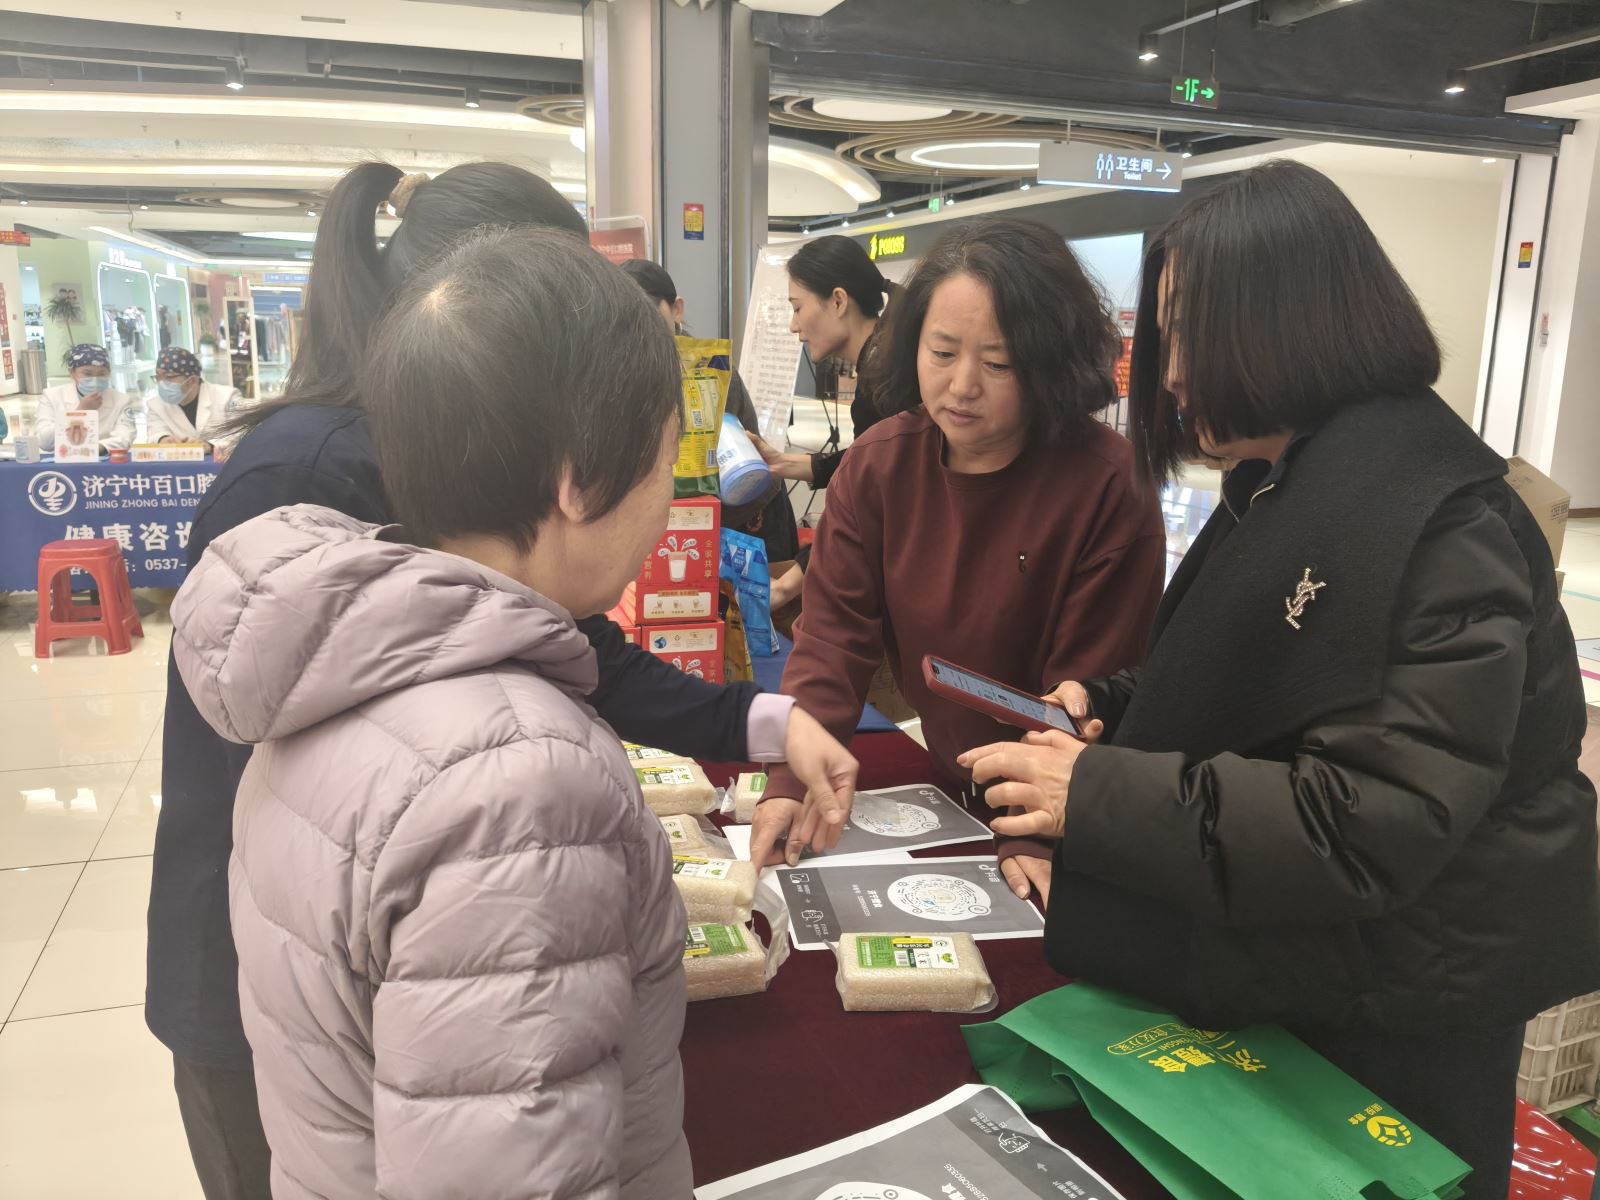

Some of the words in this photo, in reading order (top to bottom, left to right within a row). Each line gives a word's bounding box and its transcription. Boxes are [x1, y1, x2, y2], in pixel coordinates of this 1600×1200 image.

[1115, 156, 1153, 173] 卫生间
[85, 501, 119, 510] JINING
[122, 500, 158, 508] ZHONG
[162, 499, 178, 507] BAI
